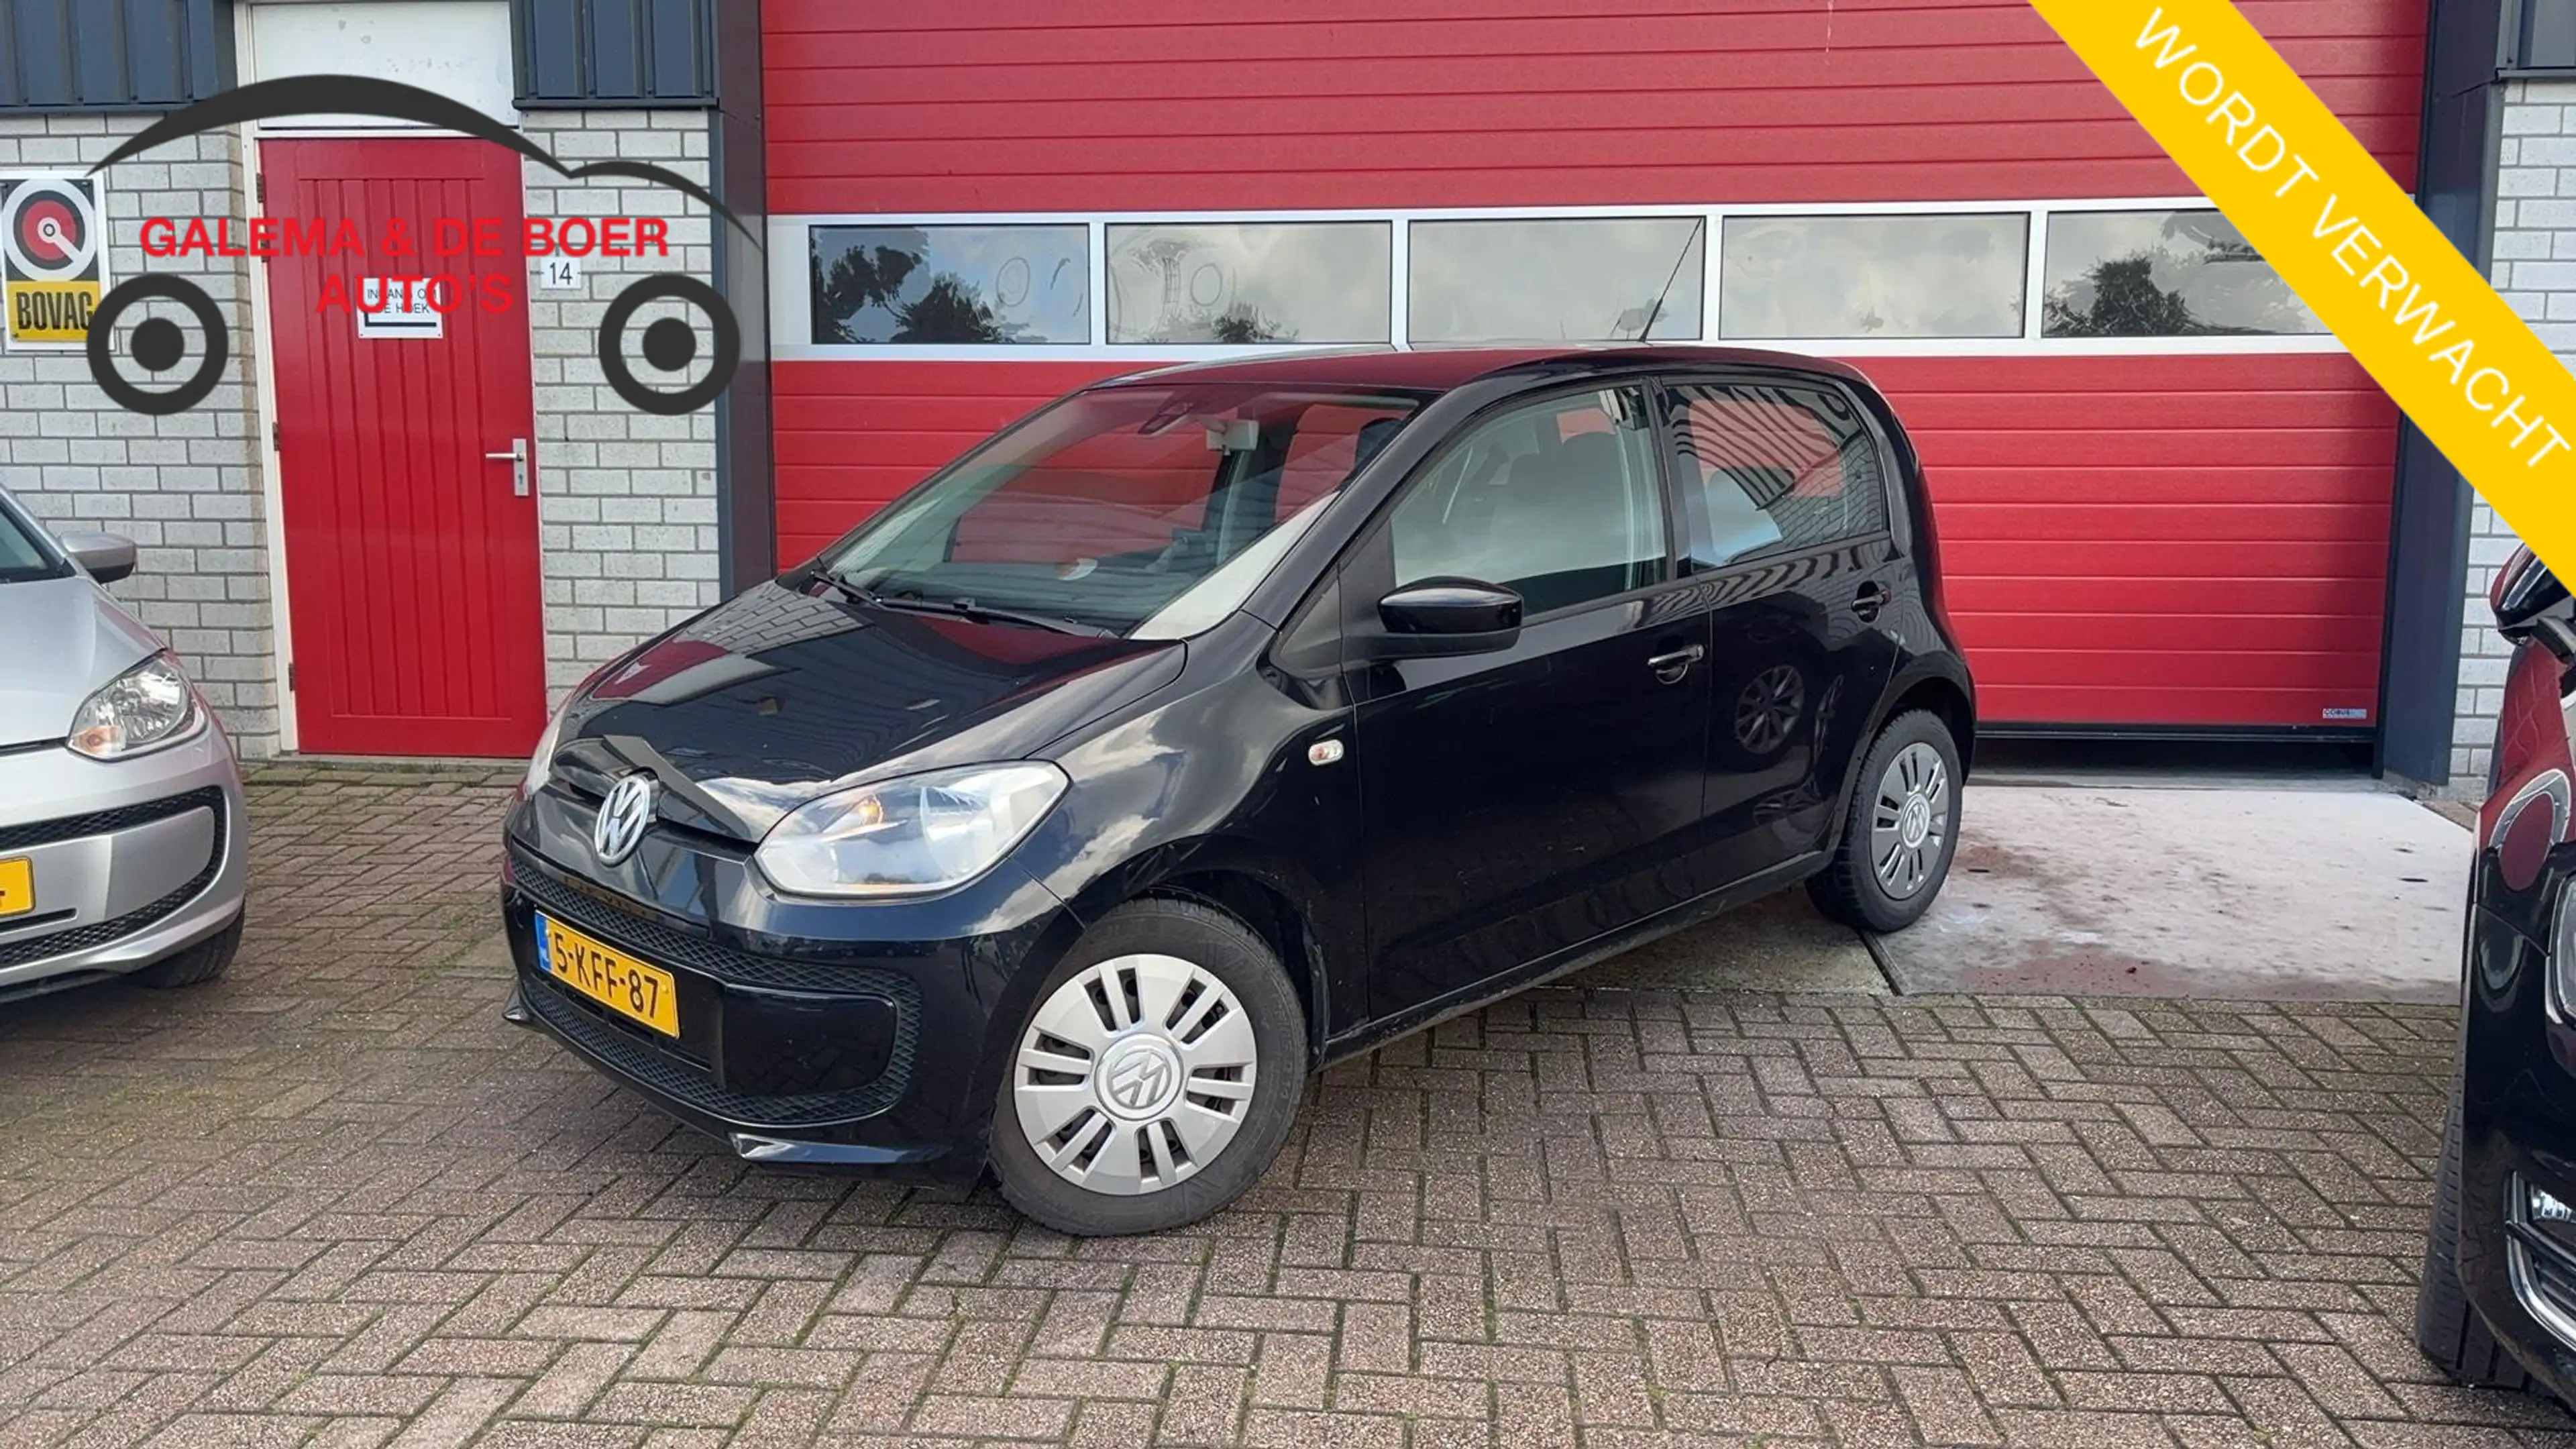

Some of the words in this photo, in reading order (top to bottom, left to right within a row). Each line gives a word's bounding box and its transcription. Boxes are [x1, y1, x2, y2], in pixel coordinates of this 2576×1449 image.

[549, 262, 572, 285] 14
[367, 288, 413, 299] INAN
[16, 291, 94, 331] BOVAG
[396, 303, 430, 314] HEK
[554, 932, 659, 1020] 5-KFF-87
